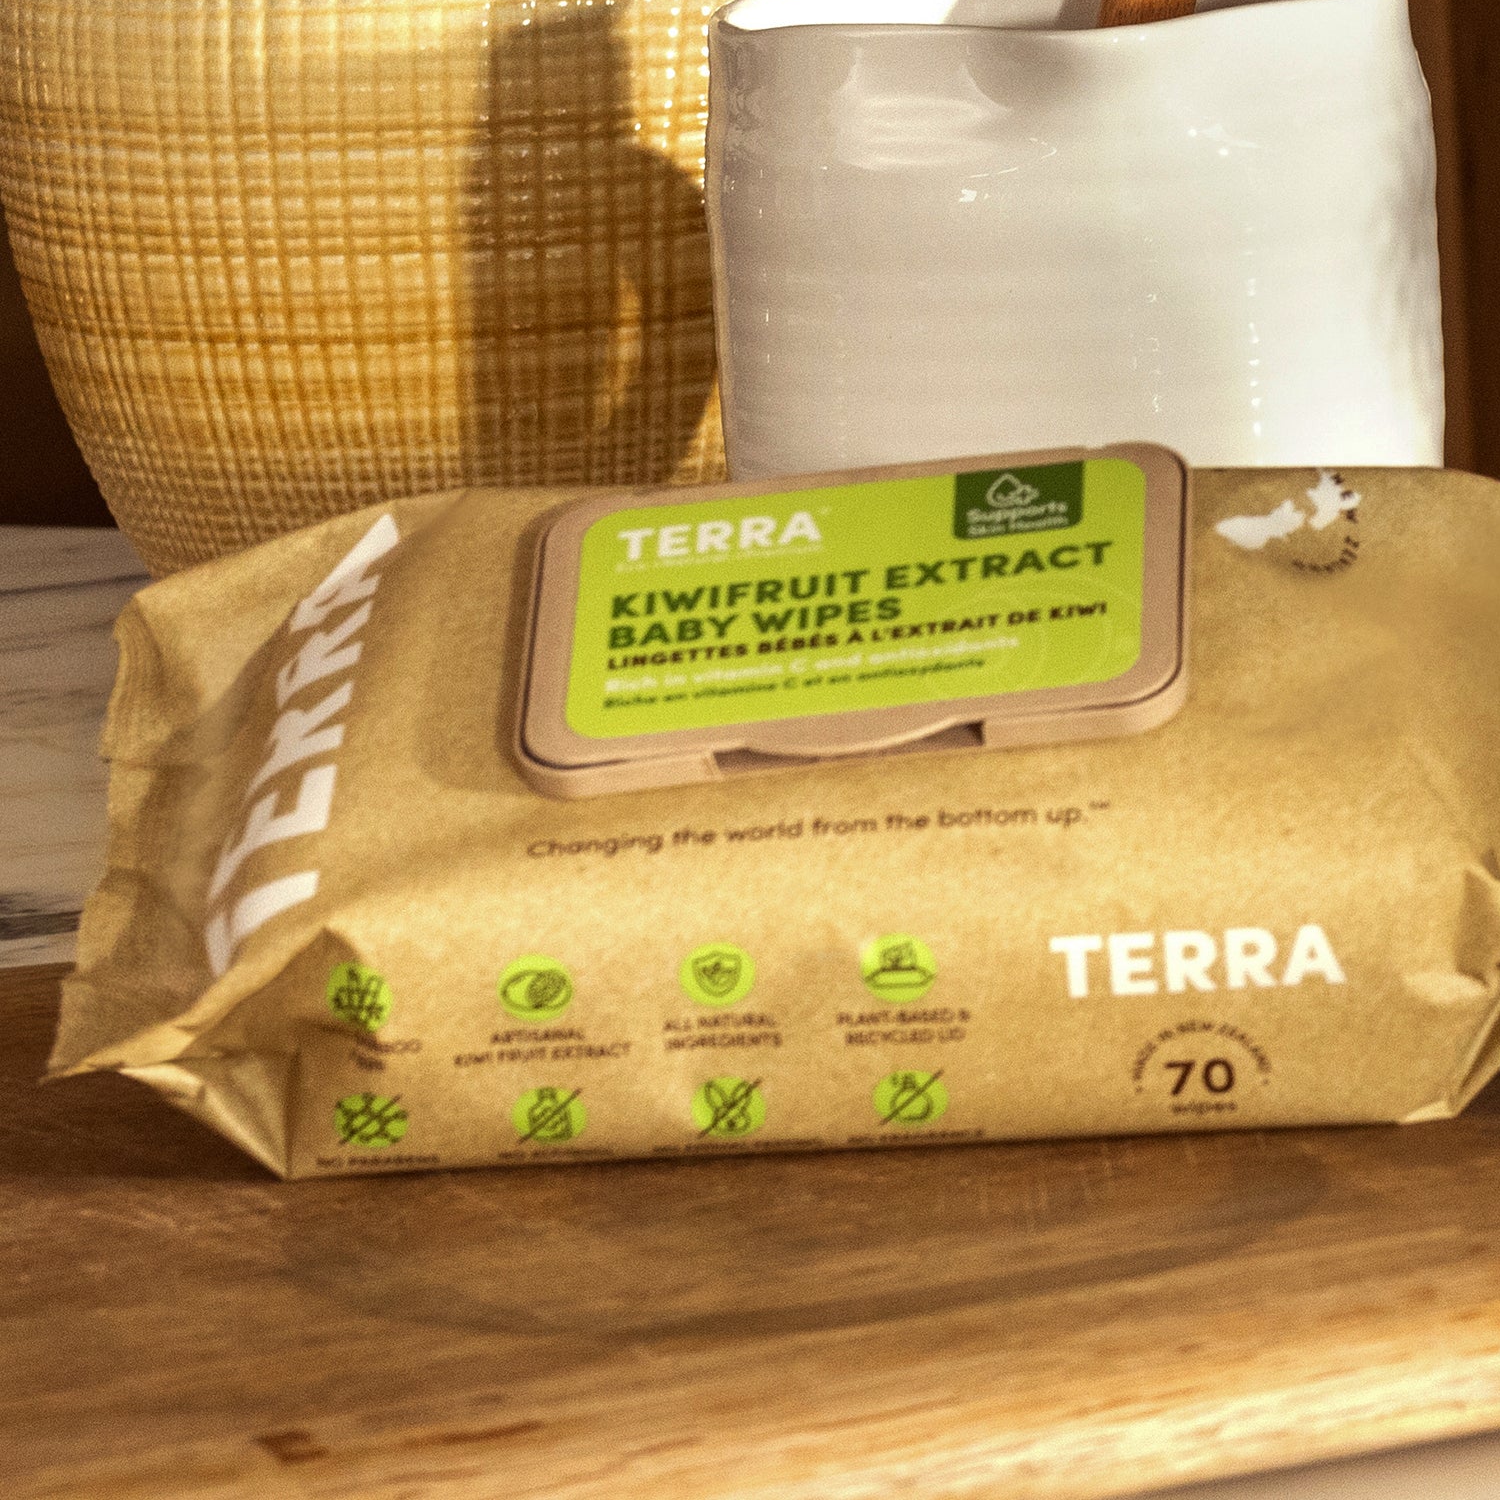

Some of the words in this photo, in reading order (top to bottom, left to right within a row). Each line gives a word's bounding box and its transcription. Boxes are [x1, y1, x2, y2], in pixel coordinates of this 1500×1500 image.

[617, 511, 822, 562] TERRA
[966, 500, 1068, 523] Supports
[611, 568, 871, 619] KIWIFRUIT
[885, 540, 1113, 590] EXTRACT
[607, 643, 748, 671] LINGETTES
[871, 614, 1000, 642] L'EXTRAIT
[1007, 608, 1040, 626] DE
[1049, 601, 1108, 621] KIWI
[608, 613, 739, 649] BABY
[752, 597, 902, 633] WIPES
[788, 656, 807, 674] C
[527, 834, 664, 859] Changing
[672, 824, 717, 845] the
[725, 819, 803, 843] world
[812, 815, 878, 835] from
[885, 812, 930, 831] the
[937, 806, 1038, 829] bottom
[1048, 923, 1347, 998] TERRA
[662, 1018, 693, 1033] ALL
[697, 1012, 779, 1030] NATURAL
[1163, 1057, 1236, 1097] 70
[1171, 1100, 1238, 1116] wipes
